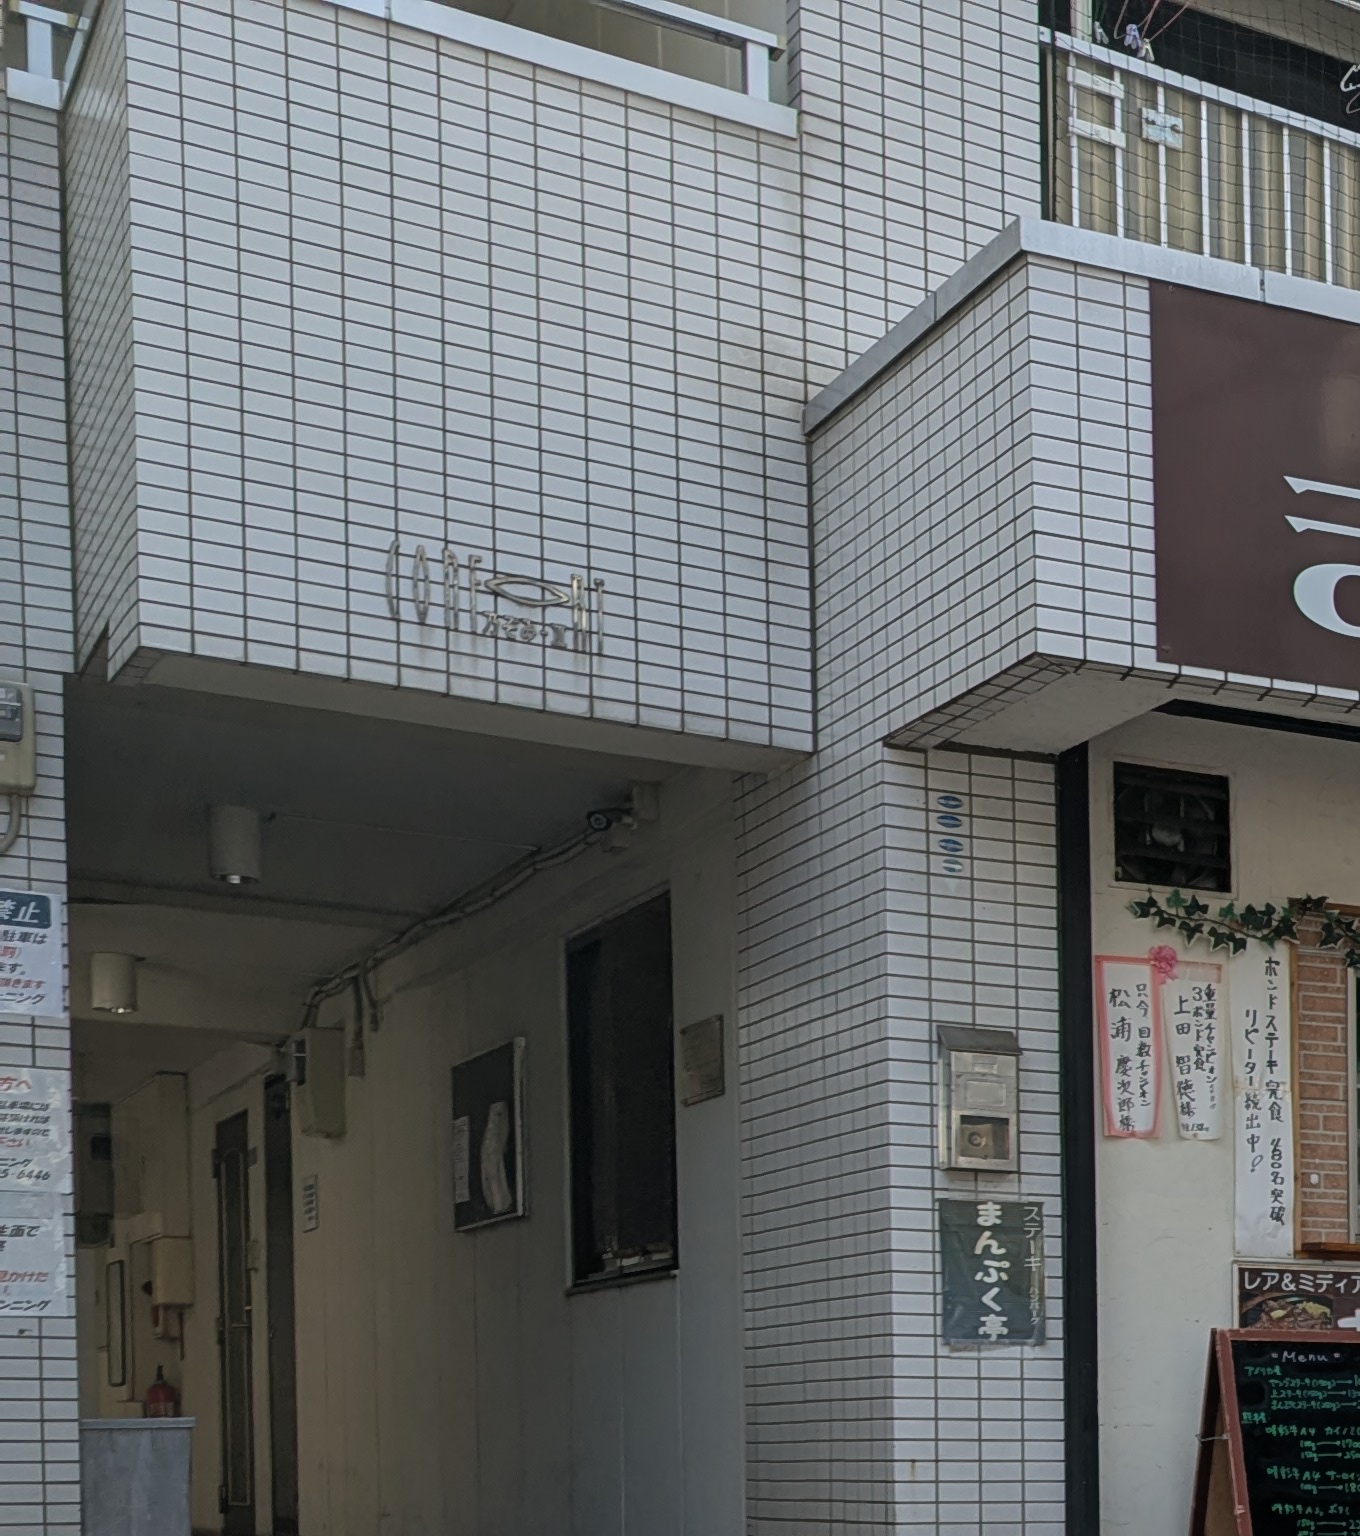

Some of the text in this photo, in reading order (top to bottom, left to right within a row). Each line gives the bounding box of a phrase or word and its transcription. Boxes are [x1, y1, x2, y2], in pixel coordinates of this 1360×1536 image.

[974, 1201, 1009, 1342] まんぷく亭
